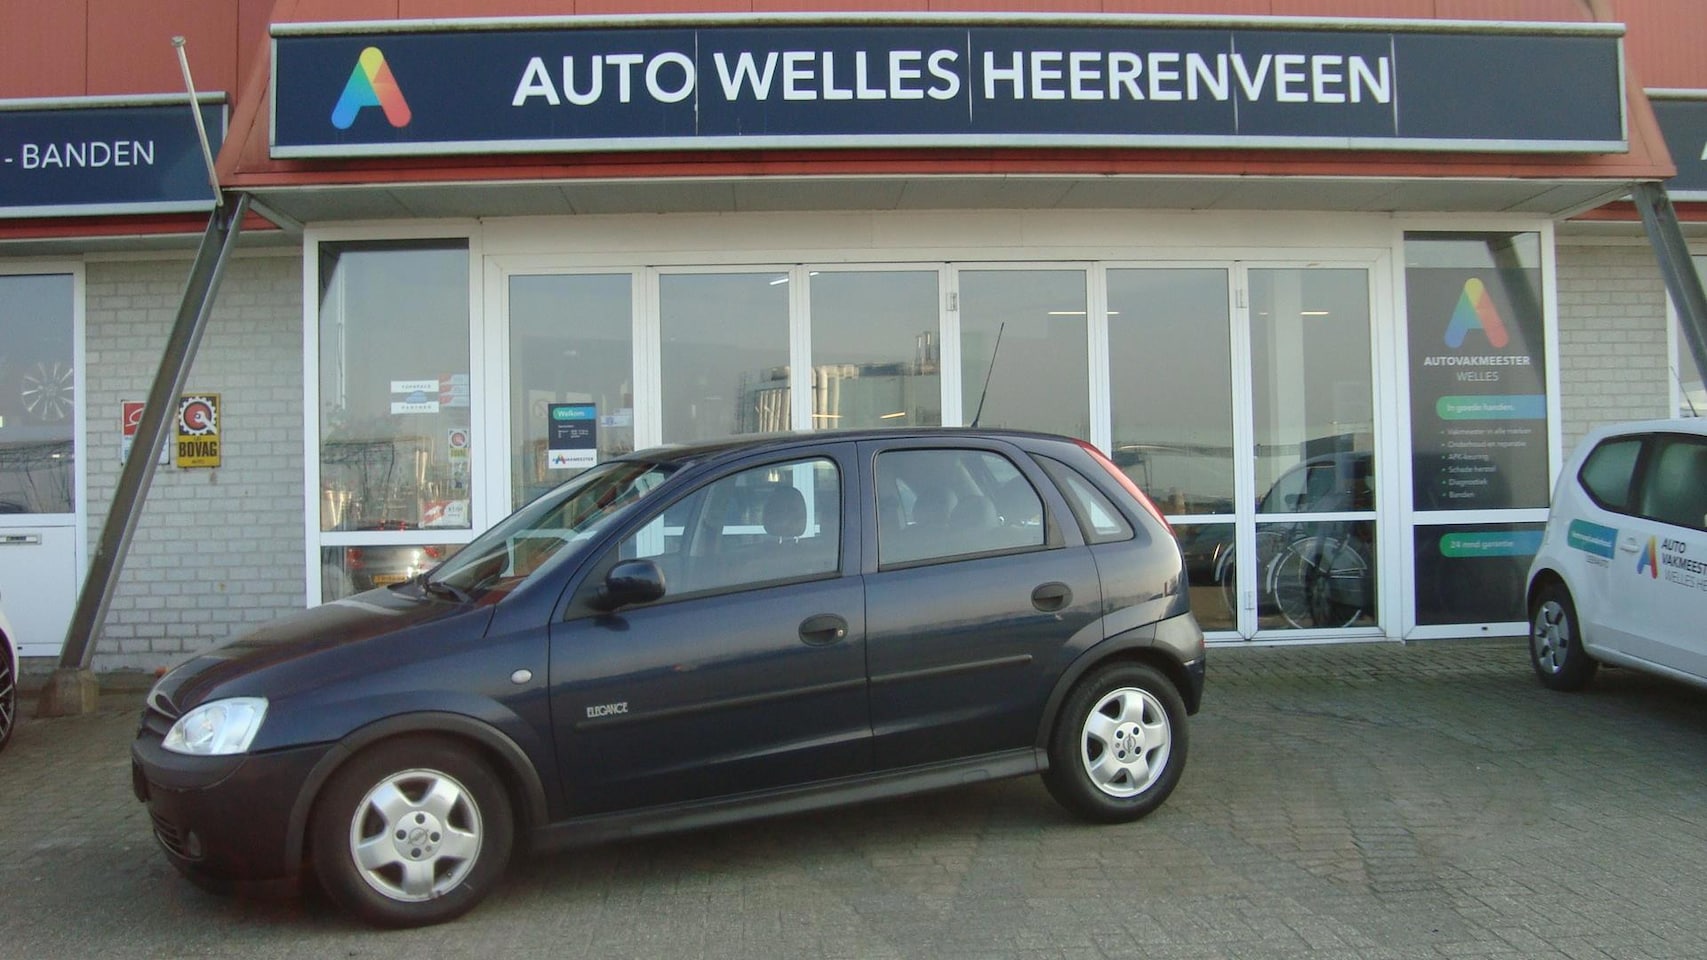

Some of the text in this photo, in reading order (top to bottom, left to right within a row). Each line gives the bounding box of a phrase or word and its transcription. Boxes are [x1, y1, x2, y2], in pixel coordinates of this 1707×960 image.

[512, 49, 1391, 106] AUTO WELLES HEERENVEEN
[22, 140, 154, 169] BANDEN
[1424, 355, 1531, 366] AUTOVAKMEESTER
[1456, 371, 1499, 382] WELLES
[1456, 403, 1482, 414] goede
[179, 441, 218, 458] BOVAG
[1450, 541, 1461, 549] 24
[1482, 541, 1514, 550] garantie
[1661, 538, 1687, 554] AUTO
[1665, 567, 1695, 588] WELLES
[586, 702, 629, 718] ELEGANCE
